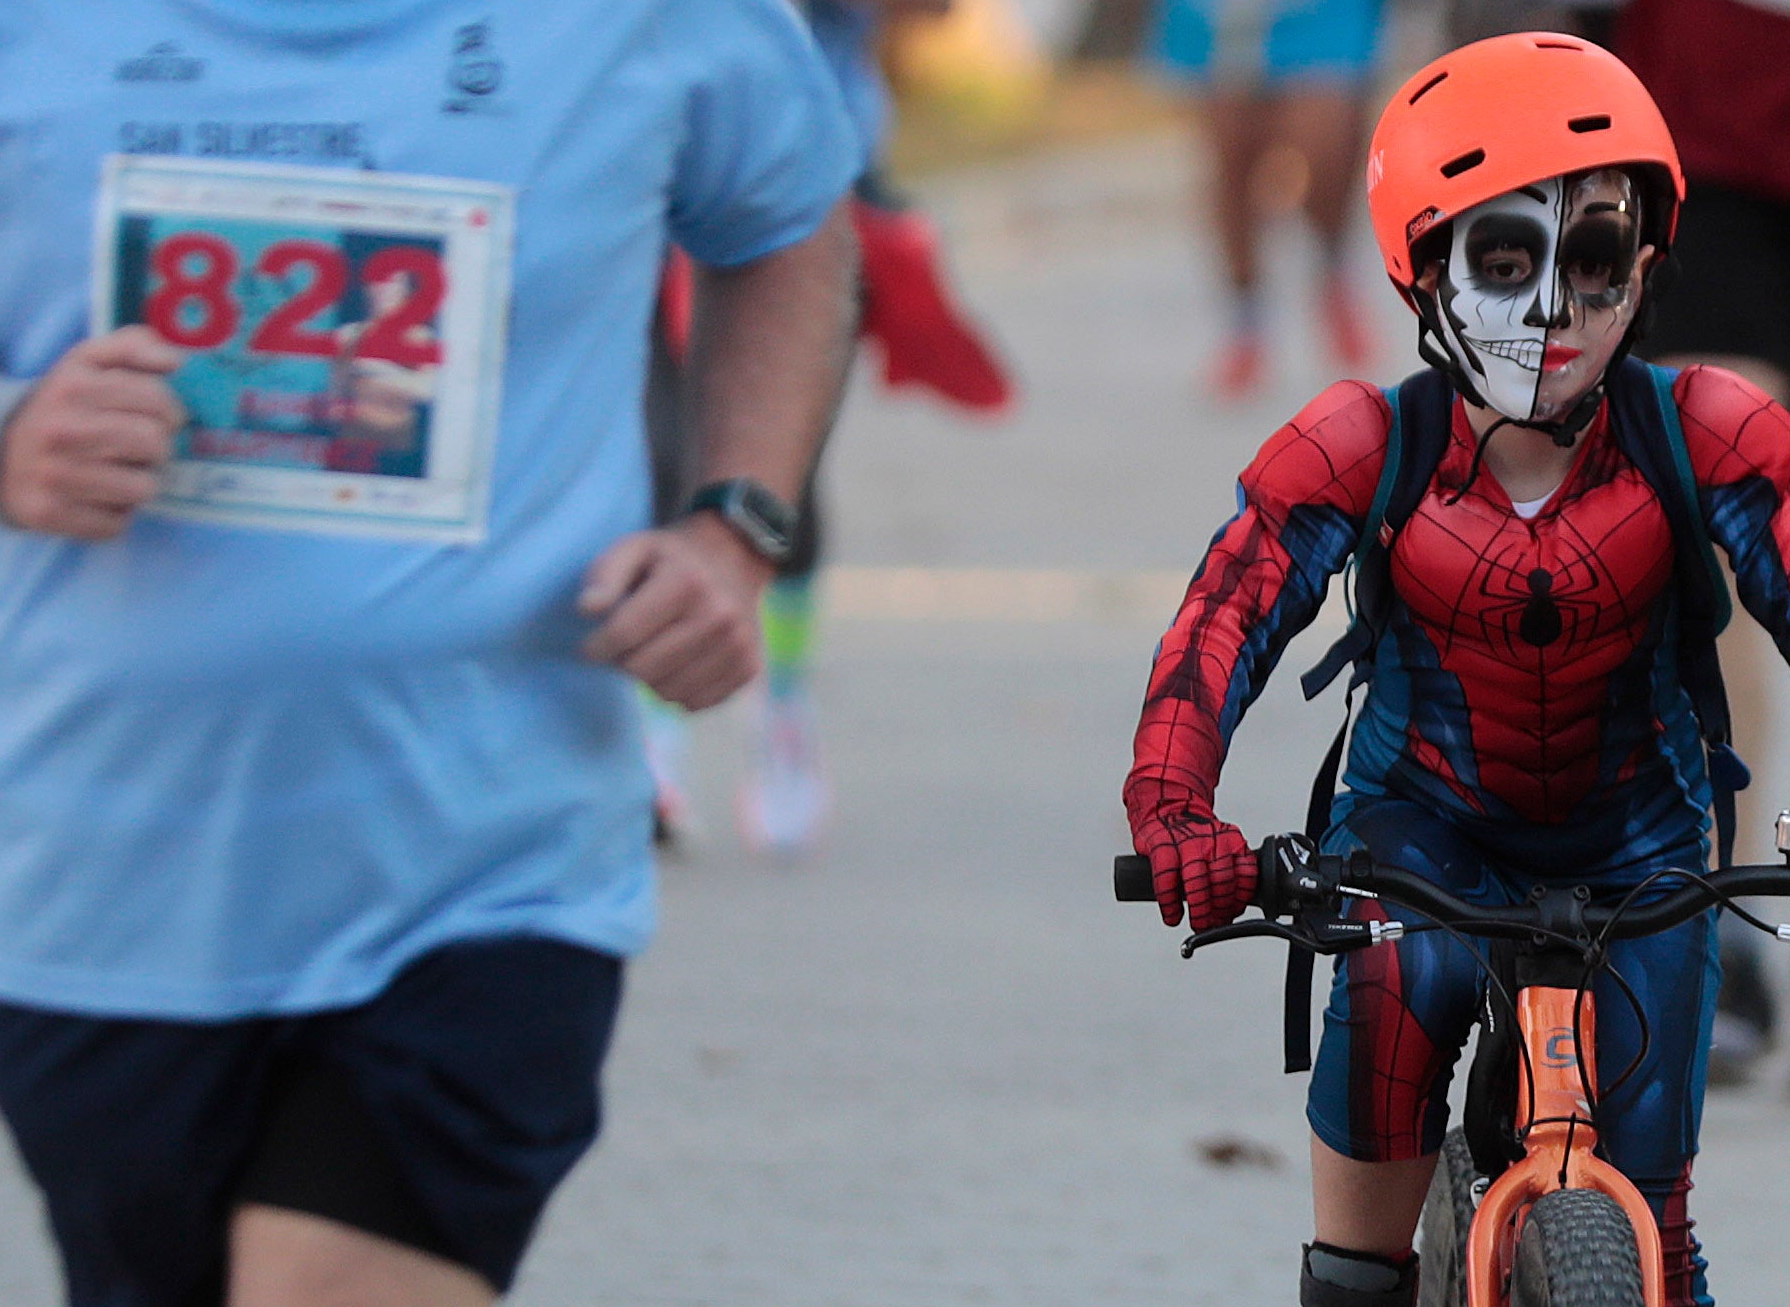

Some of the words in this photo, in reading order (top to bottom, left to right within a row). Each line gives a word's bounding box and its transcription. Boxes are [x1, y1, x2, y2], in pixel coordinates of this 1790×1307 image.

[119, 121, 182, 155] SAN
[195, 121, 362, 158] SILVESTRE
[144, 229, 448, 369] 822
